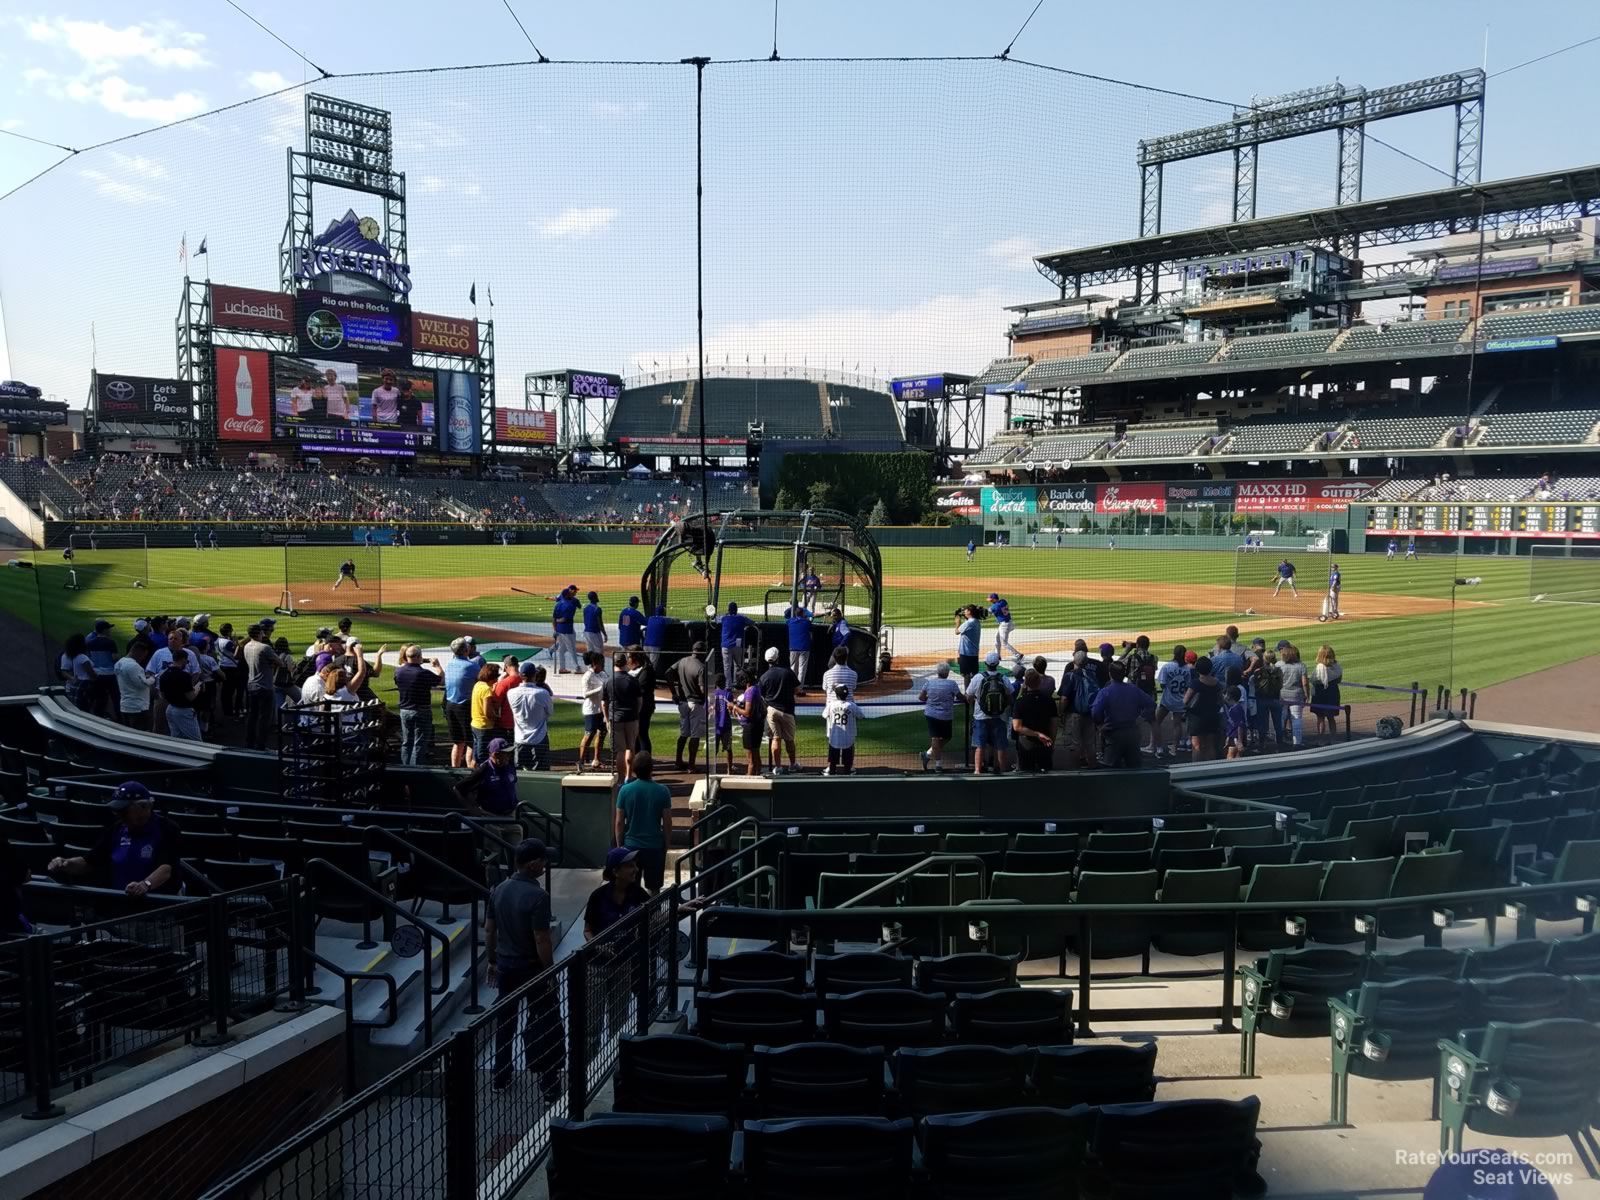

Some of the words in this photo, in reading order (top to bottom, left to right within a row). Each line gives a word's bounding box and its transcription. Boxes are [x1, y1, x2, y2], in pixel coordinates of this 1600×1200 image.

[294, 247, 412, 294] ROCKIES
[225, 300, 283, 319] uchealth
[322, 296, 336, 306] Rio
[350, 300, 364, 309] the
[366, 302, 390, 312] Rocks
[418, 319, 470, 336] WELLS
[420, 332, 469, 350] FARGO
[572, 374, 608, 384] COLORADO
[0, 384, 26, 394] OYOTA
[153, 384, 176, 394] Let's
[572, 382, 620, 398] ROCKIES
[902, 390, 924, 398] METS
[153, 394, 167, 403] Go
[154, 403, 187, 414] Places
[507, 412, 545, 427] KING
[506, 426, 546, 440] Soopers
[1050, 488, 1073, 499] Bank
[1075, 488, 1086, 499] of
[1168, 487, 1197, 499] Exxon
[1203, 486, 1231, 496] Mobil
[1238, 484, 1282, 495] MAXX
[1285, 484, 1306, 495] HD
[937, 497, 974, 506] Safelite
[990, 497, 1027, 512] dental
[1050, 499, 1094, 510] Colorado
[1171, 681, 1187, 694] 28
[834, 713, 848, 725] 28
